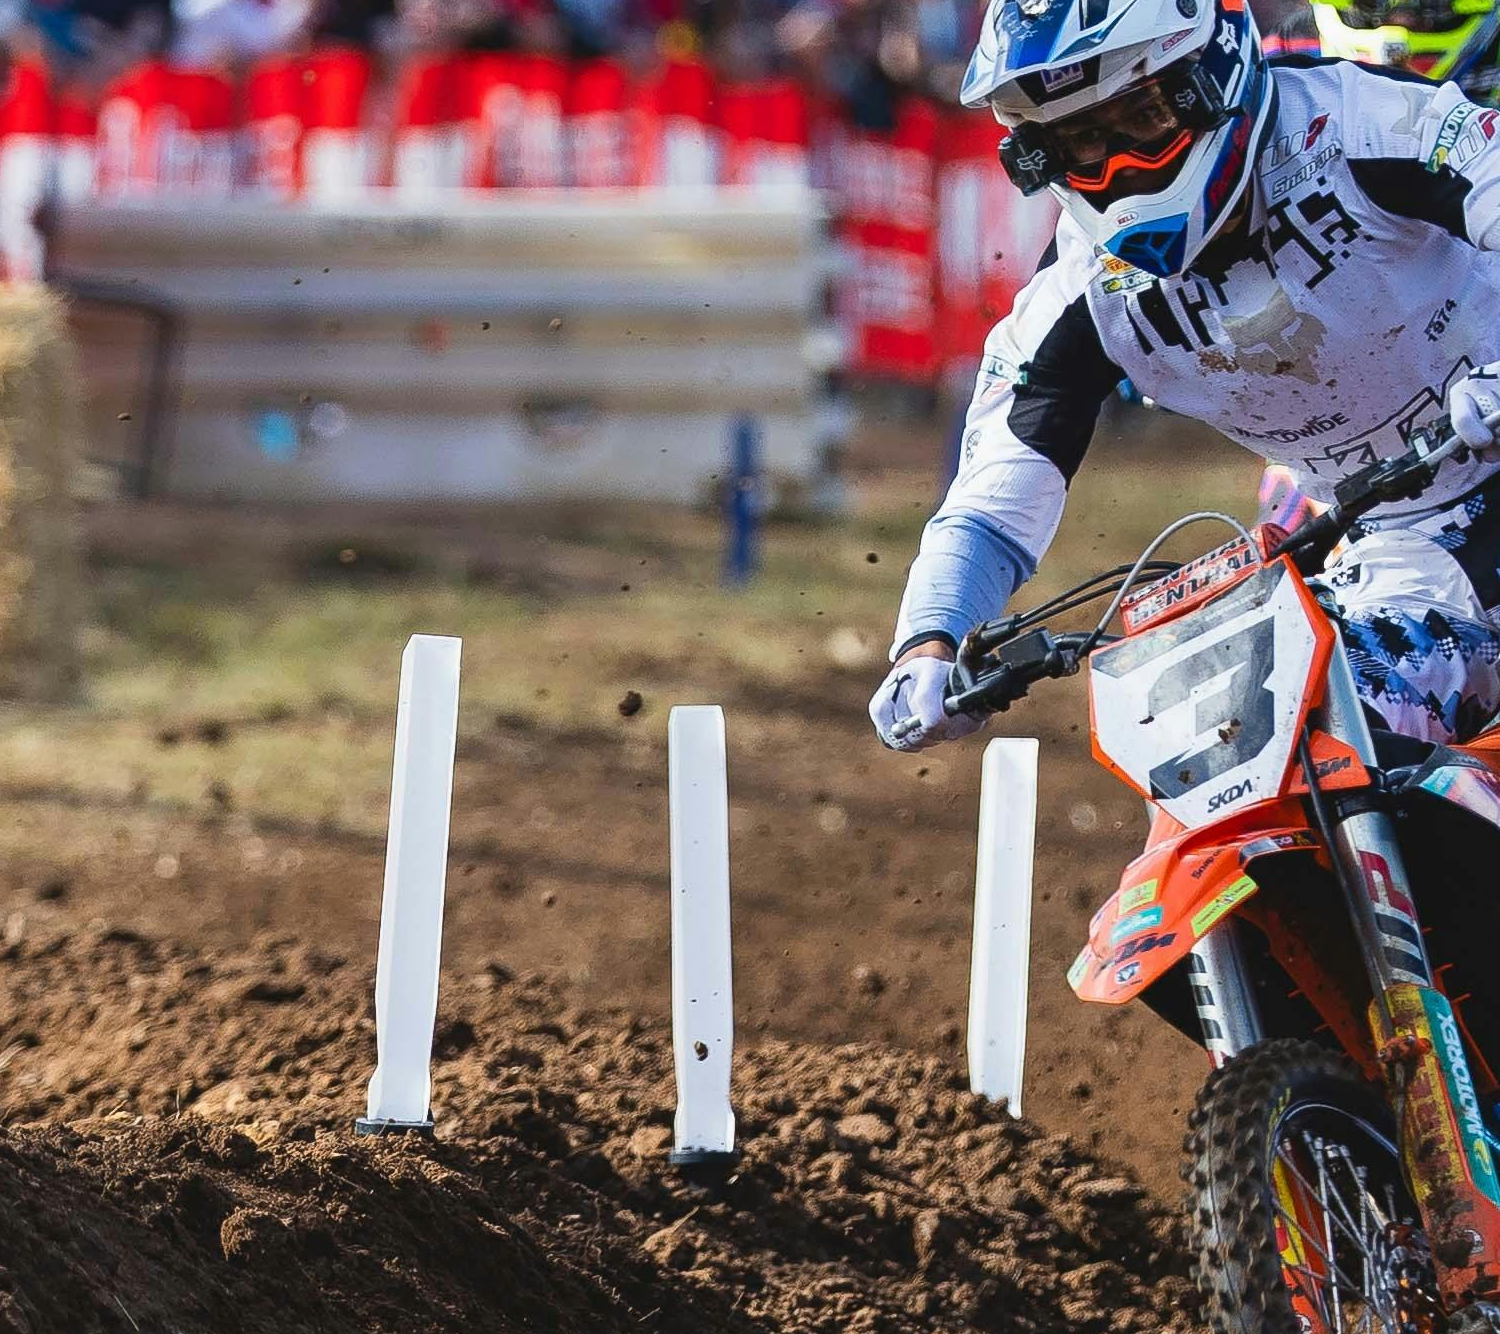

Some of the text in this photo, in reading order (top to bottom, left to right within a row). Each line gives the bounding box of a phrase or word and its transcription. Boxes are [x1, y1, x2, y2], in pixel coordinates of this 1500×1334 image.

[1149, 615, 1275, 799] 3
[1206, 778, 1253, 814] SKDA
[1434, 1013, 1482, 1134] MOTOREX
